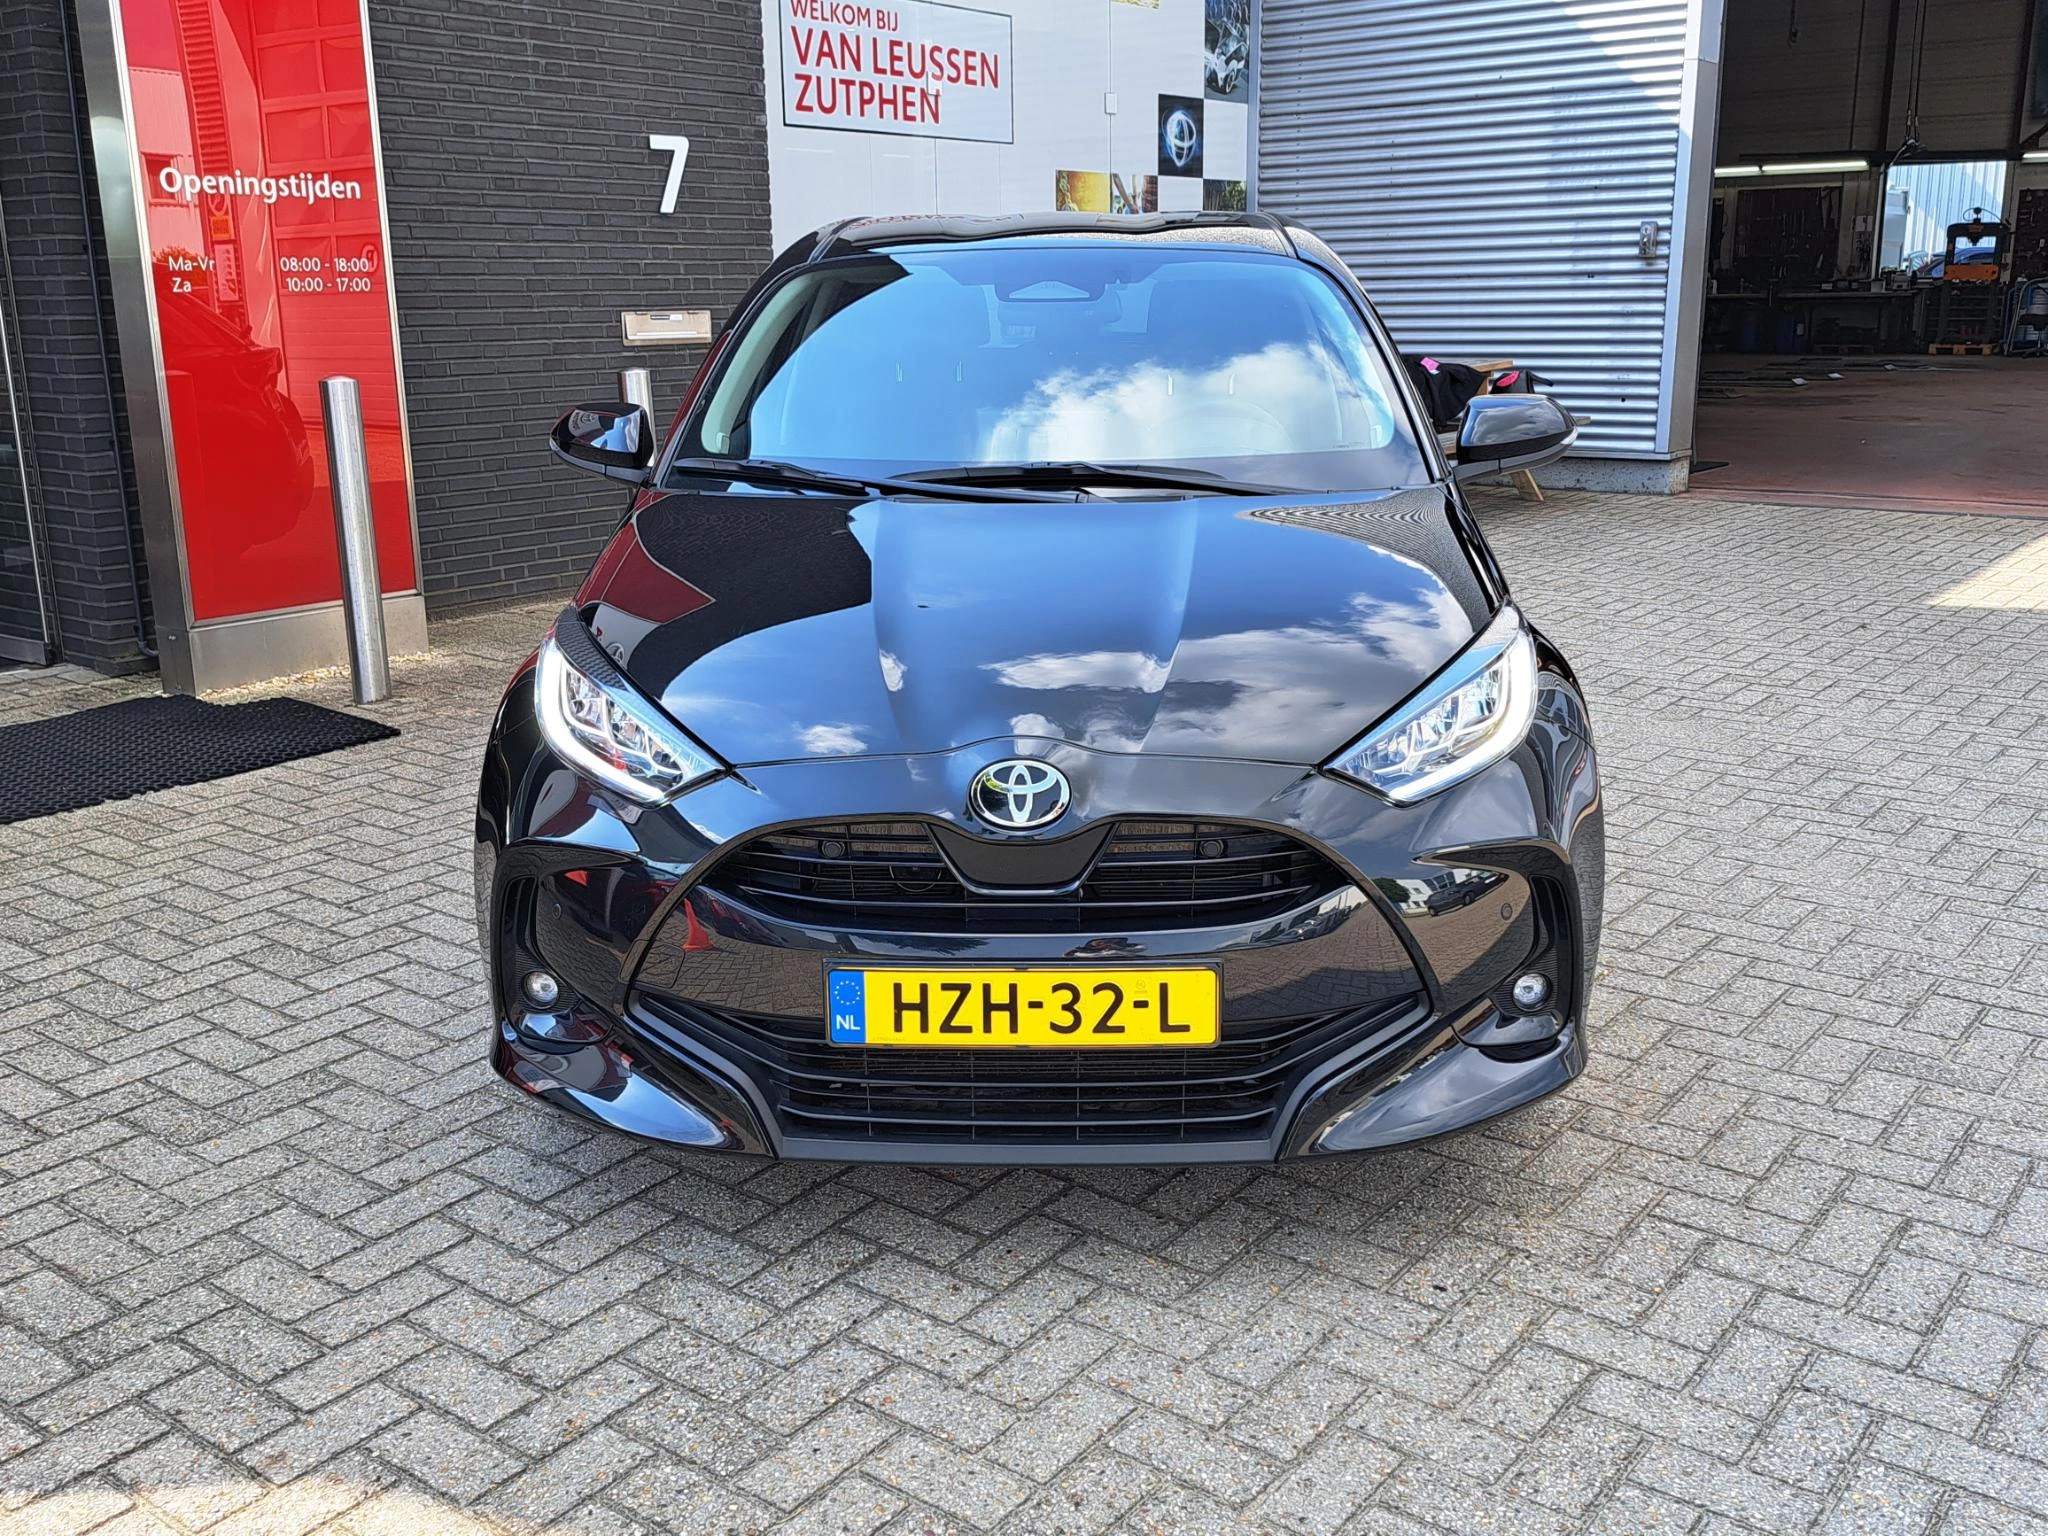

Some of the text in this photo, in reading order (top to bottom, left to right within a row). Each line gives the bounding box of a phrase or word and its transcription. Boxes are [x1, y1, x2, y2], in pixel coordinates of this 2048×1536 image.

[791, 0, 899, 31] WELKOM BIJ
[791, 25, 999, 88] VAN LEUSSEN
[794, 73, 940, 124] ZUTPHEN
[159, 166, 361, 205] Openingstijden
[649, 134, 690, 214] 7
[168, 256, 215, 272] Ma-Vr
[280, 257, 321, 272] 08:00
[334, 257, 369, 272] 18:00
[172, 277, 192, 293] Za
[286, 277, 323, 292] 10:00
[336, 277, 371, 292] 17:00
[836, 1015, 861, 1031] NL
[893, 982, 1191, 1034] HZH-32-L
